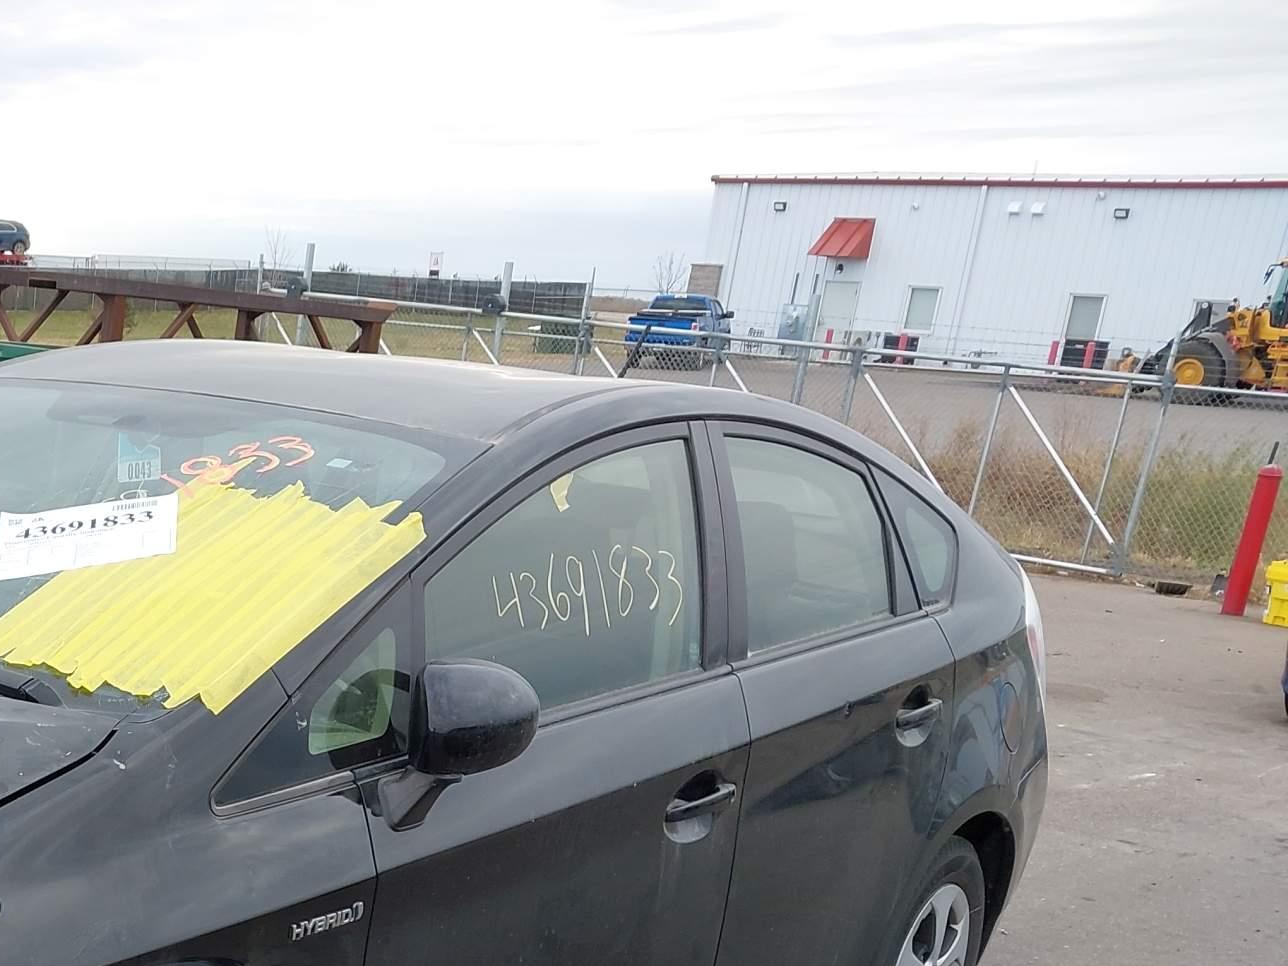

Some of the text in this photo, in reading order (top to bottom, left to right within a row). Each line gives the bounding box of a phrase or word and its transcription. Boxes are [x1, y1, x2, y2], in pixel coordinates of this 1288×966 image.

[127, 460, 153, 481] 0043
[15, 510, 155, 540] 43691833
[491, 544, 684, 637] 43691833
[291, 906, 355, 941] HYBRID
